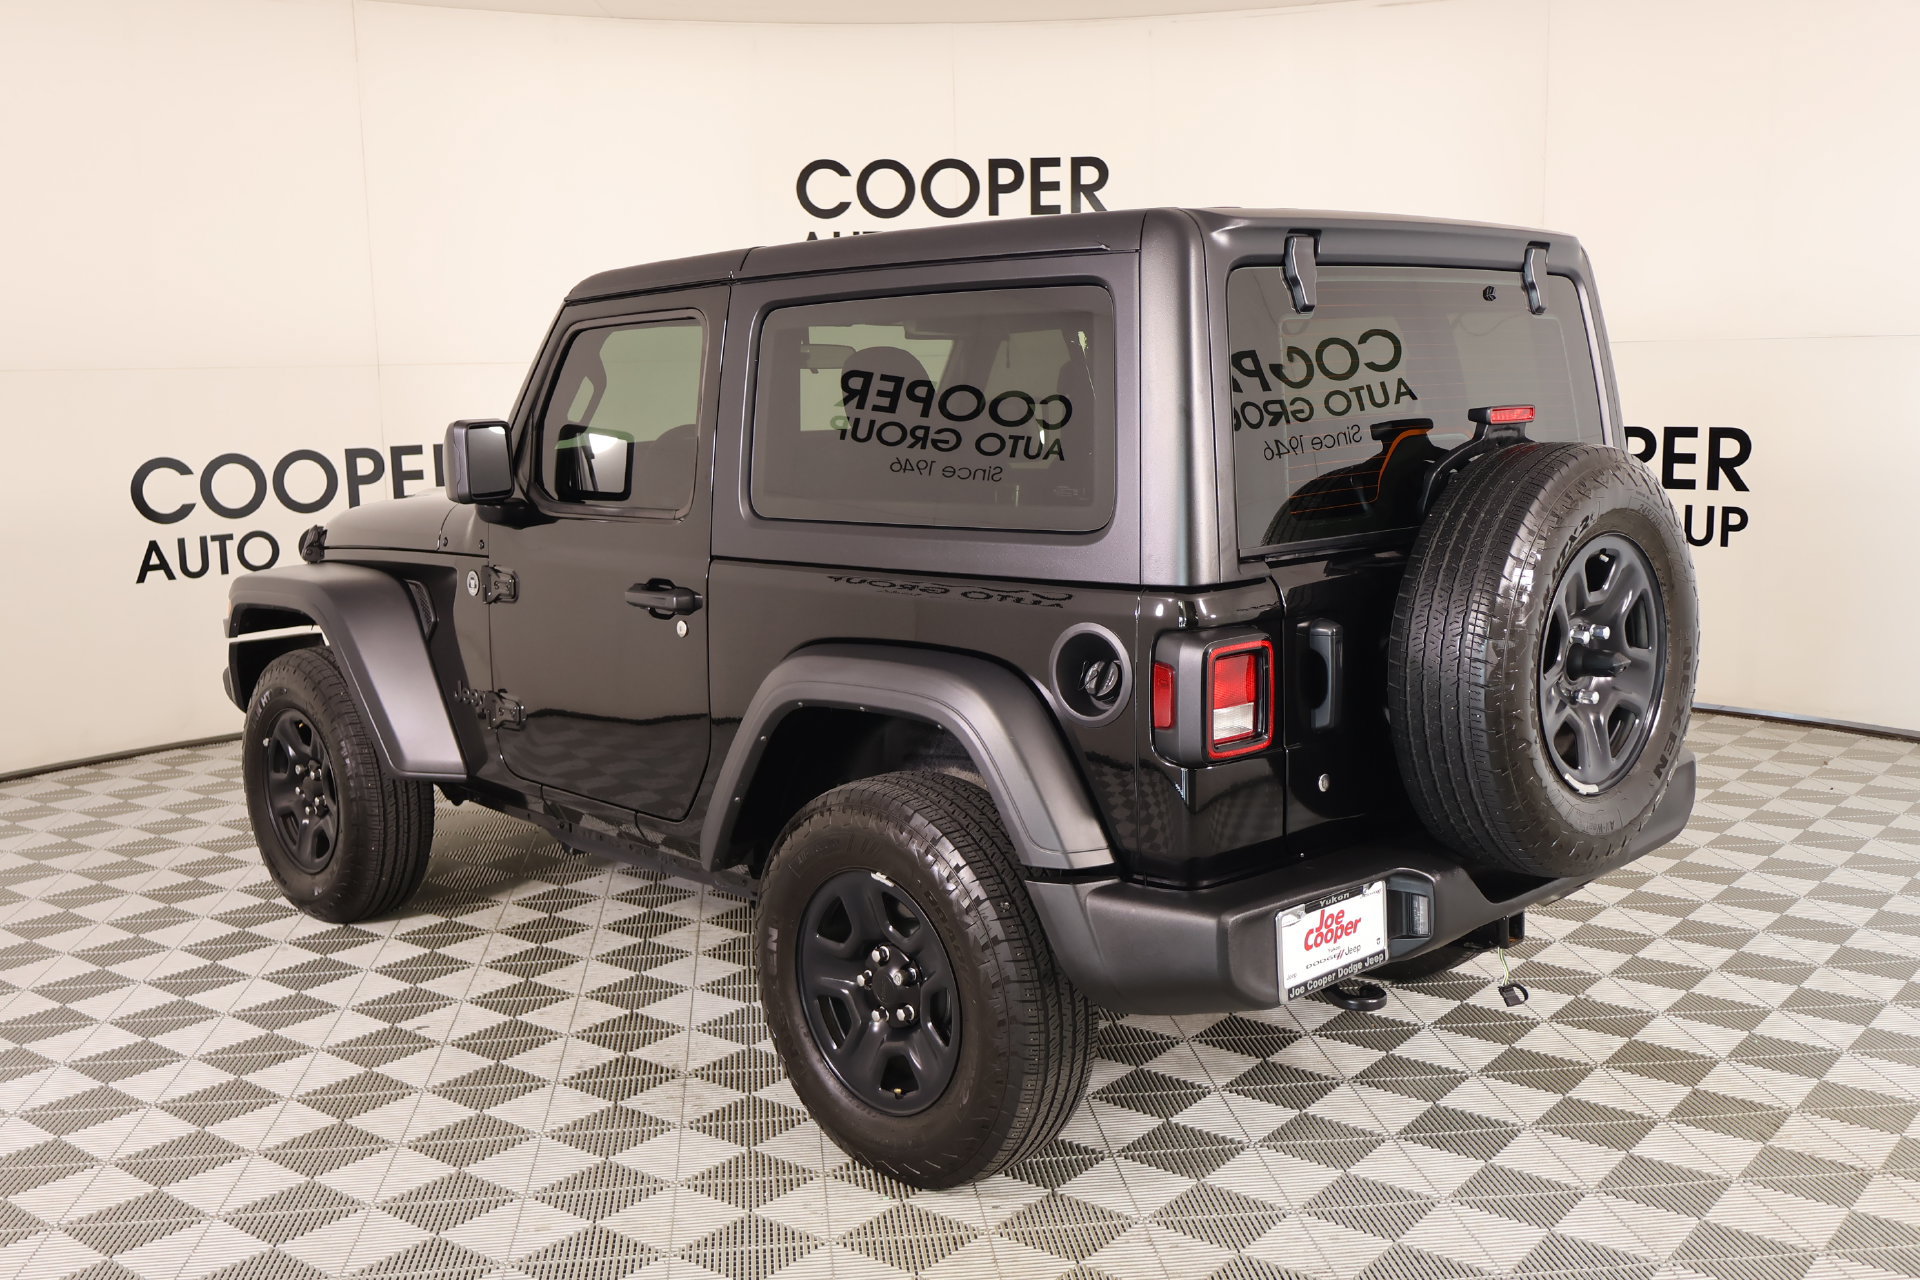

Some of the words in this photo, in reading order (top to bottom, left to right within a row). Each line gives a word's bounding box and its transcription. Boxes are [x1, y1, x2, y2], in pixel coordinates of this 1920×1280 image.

[796, 156, 1109, 219] COOPER
[130, 444, 445, 525] COOPE
[135, 530, 280, 584] AUTO
[1653, 646, 1693, 780] NEXEN
[1315, 909, 1345, 933] Joe
[1319, 892, 1350, 907] Yukon
[1304, 917, 1361, 951] Cooper
[1345, 944, 1361, 957] Jeep
[1289, 986, 1305, 998] Joe
[1307, 972, 1336, 990] Cooper
[1338, 961, 1362, 977] Dodge
[1364, 953, 1384, 966] Jeep
